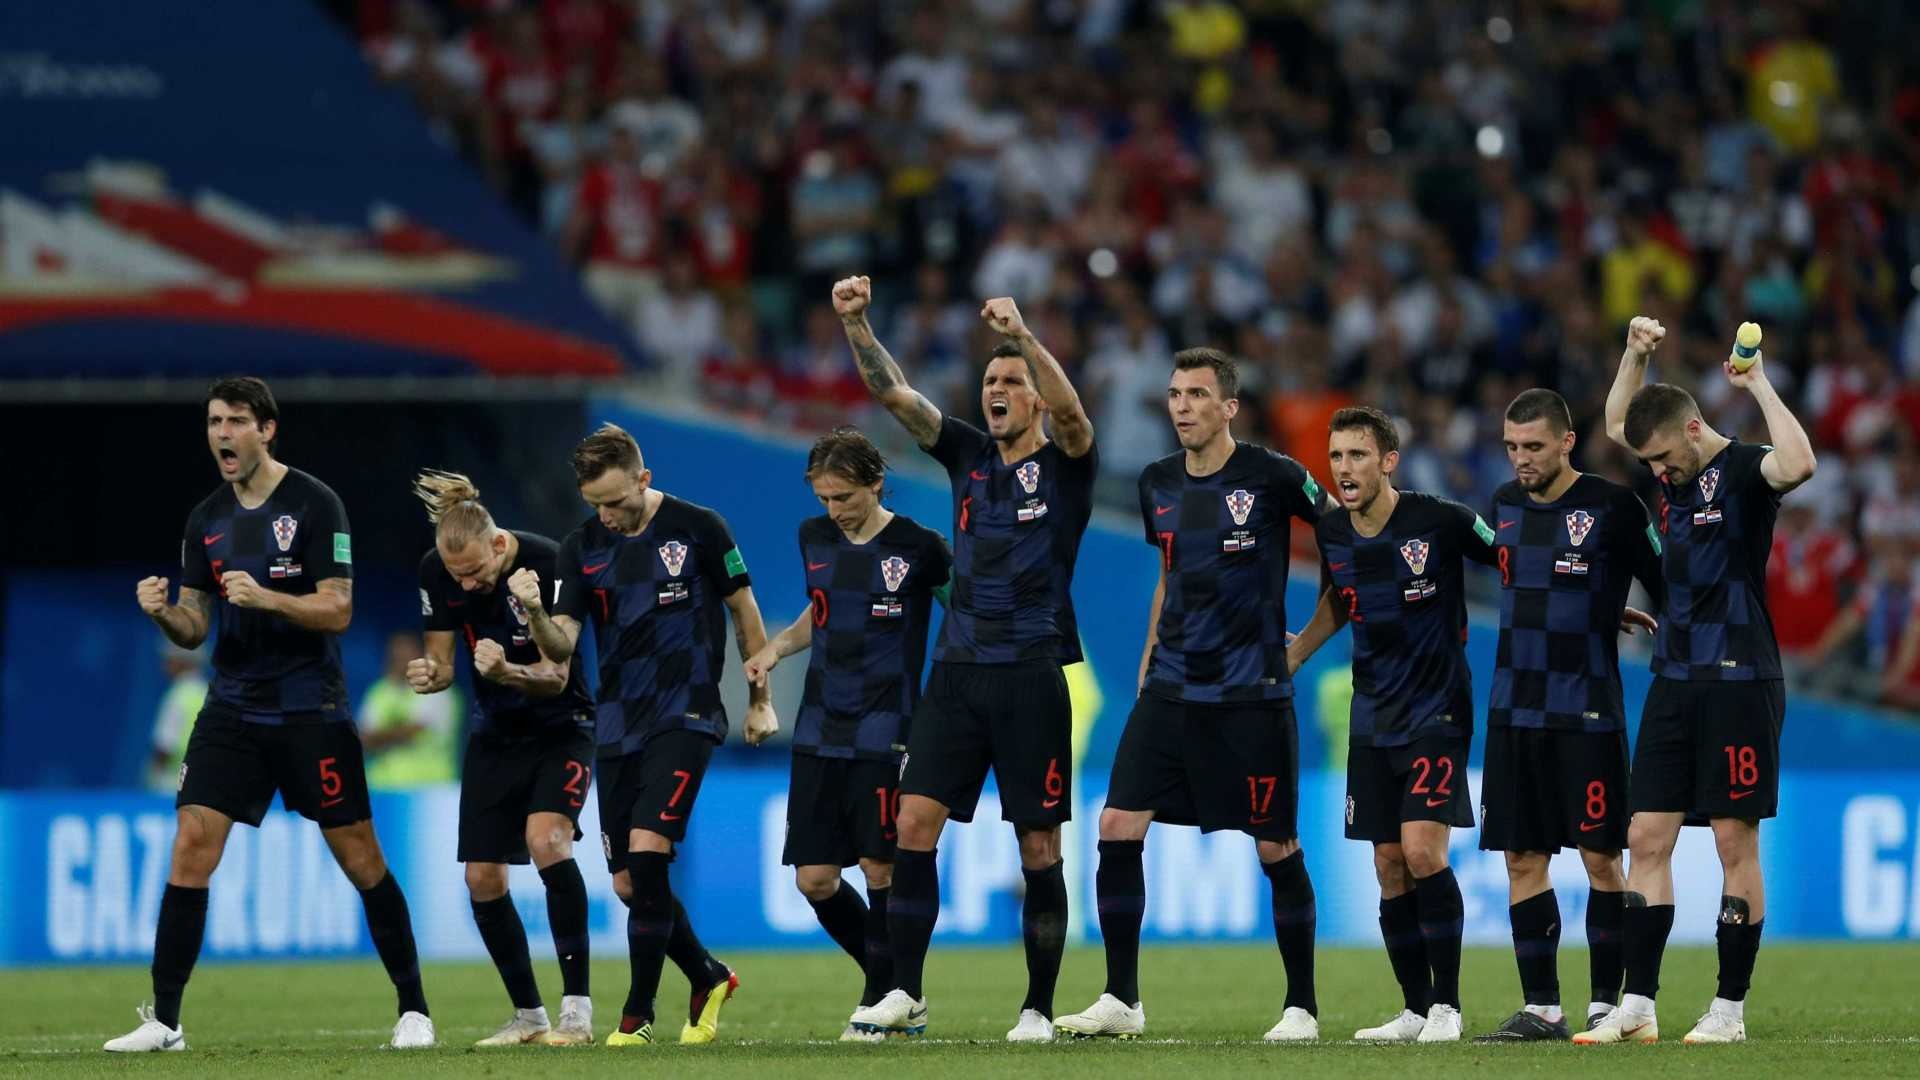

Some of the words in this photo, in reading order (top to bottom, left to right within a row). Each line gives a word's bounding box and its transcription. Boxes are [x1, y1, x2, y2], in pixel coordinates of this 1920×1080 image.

[1338, 586, 1364, 623] 2
[319, 756, 344, 798] 5
[563, 760, 591, 796] 21
[1044, 757, 1065, 798] 6
[1409, 756, 1454, 796] 22
[1722, 745, 1759, 786] 18
[672, 770, 692, 808] 7
[1246, 776, 1278, 816] 17
[1585, 780, 1607, 821] 8
[47, 813, 361, 957] GAZROM
